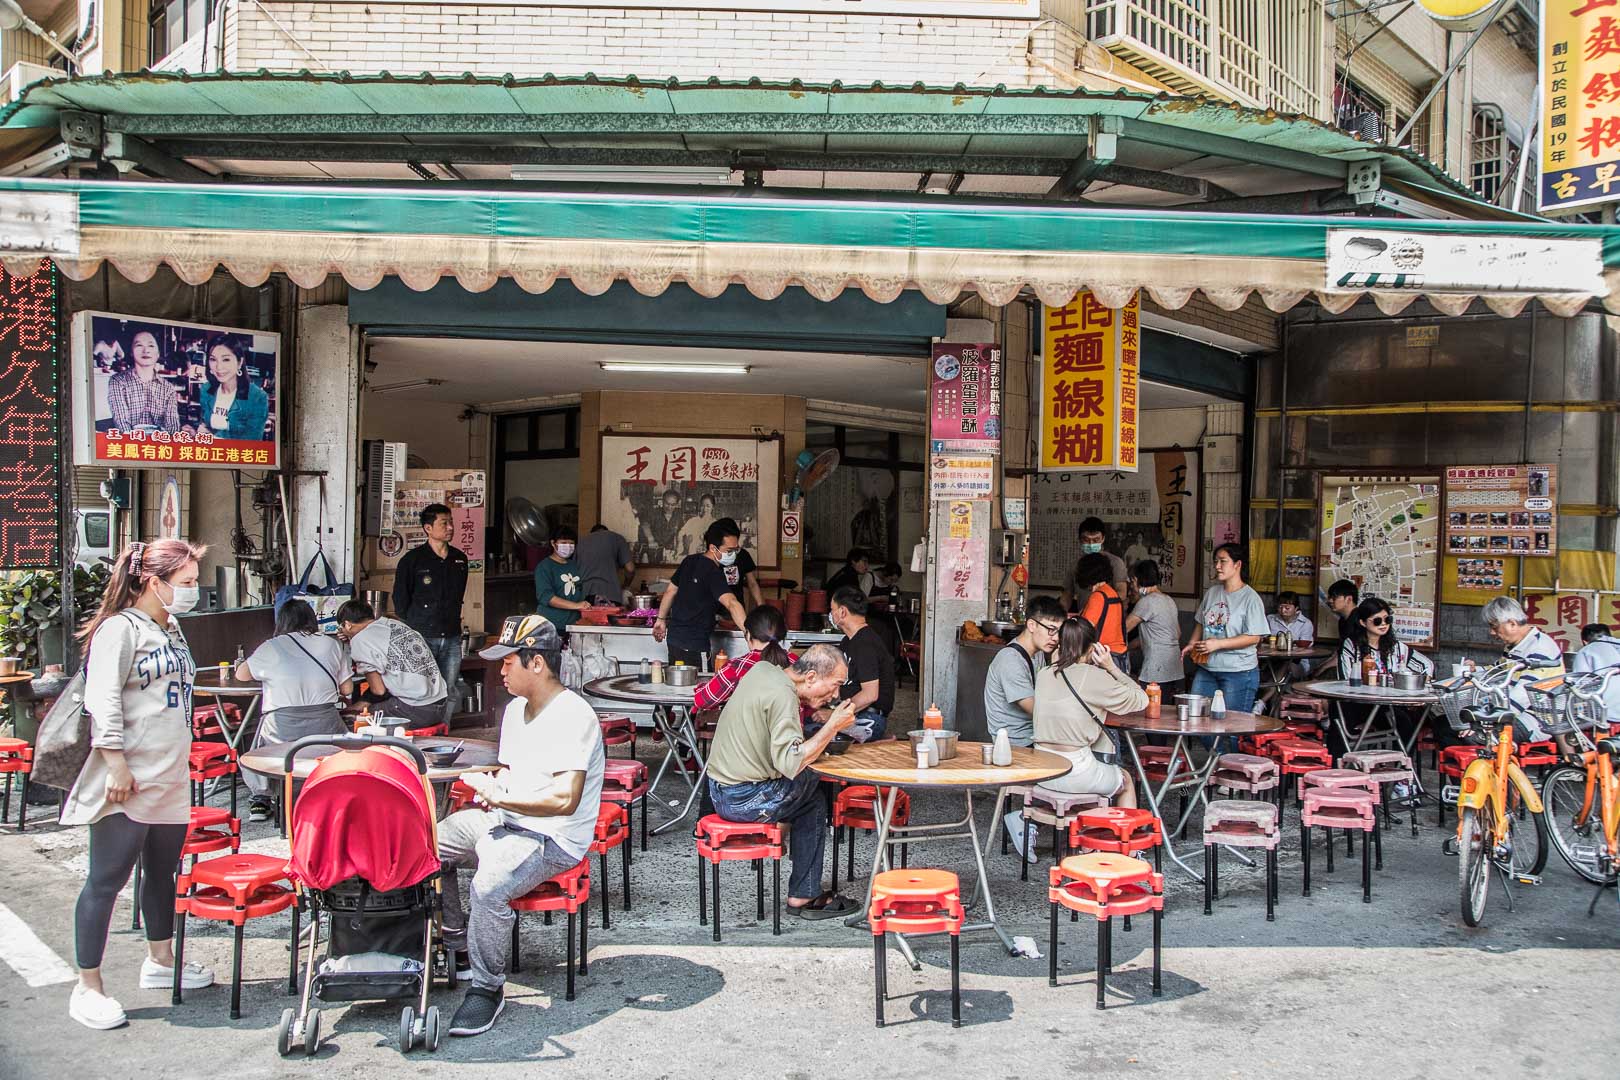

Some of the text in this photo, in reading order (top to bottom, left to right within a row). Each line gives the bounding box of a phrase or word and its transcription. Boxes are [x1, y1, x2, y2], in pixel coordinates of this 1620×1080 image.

[1551, 41, 1568, 163] 創立於民國19年
[106, 443, 269, 463] 美鳳有約 採訪正港老店
[702, 448, 730, 460] 1930
[701, 461, 760, 480] 麵線糊
